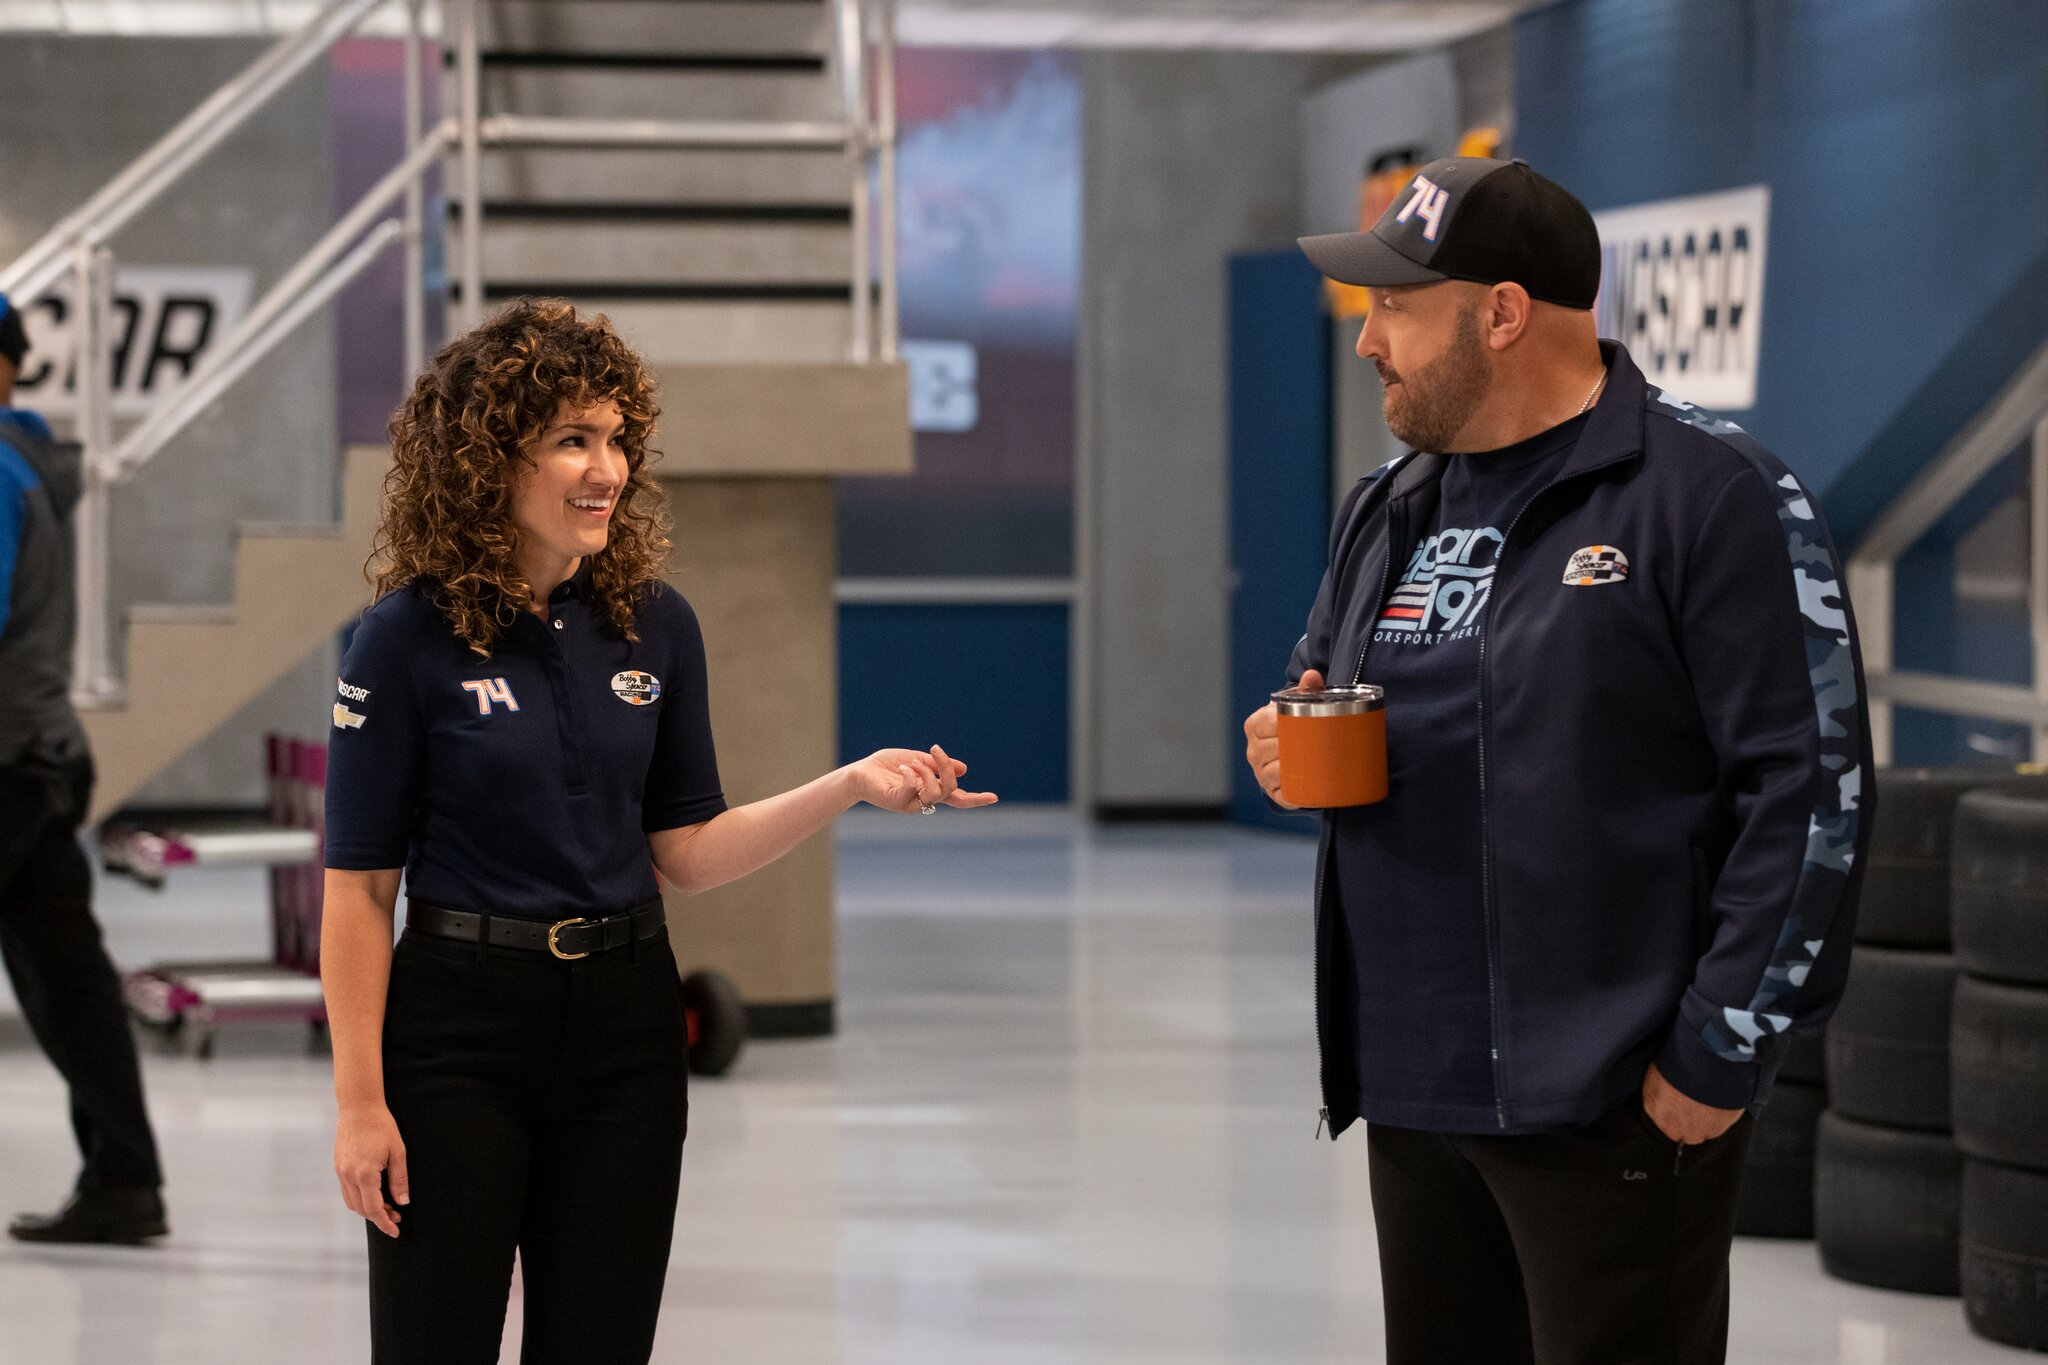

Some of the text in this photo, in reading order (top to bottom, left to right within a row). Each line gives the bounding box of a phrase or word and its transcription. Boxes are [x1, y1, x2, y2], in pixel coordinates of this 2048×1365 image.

[1395, 175, 1449, 243] 74
[14, 295, 216, 393] CAR
[1419, 577, 1493, 631] 197
[1374, 625, 1481, 645] ORSPORT HERI
[461, 677, 520, 716] 74
